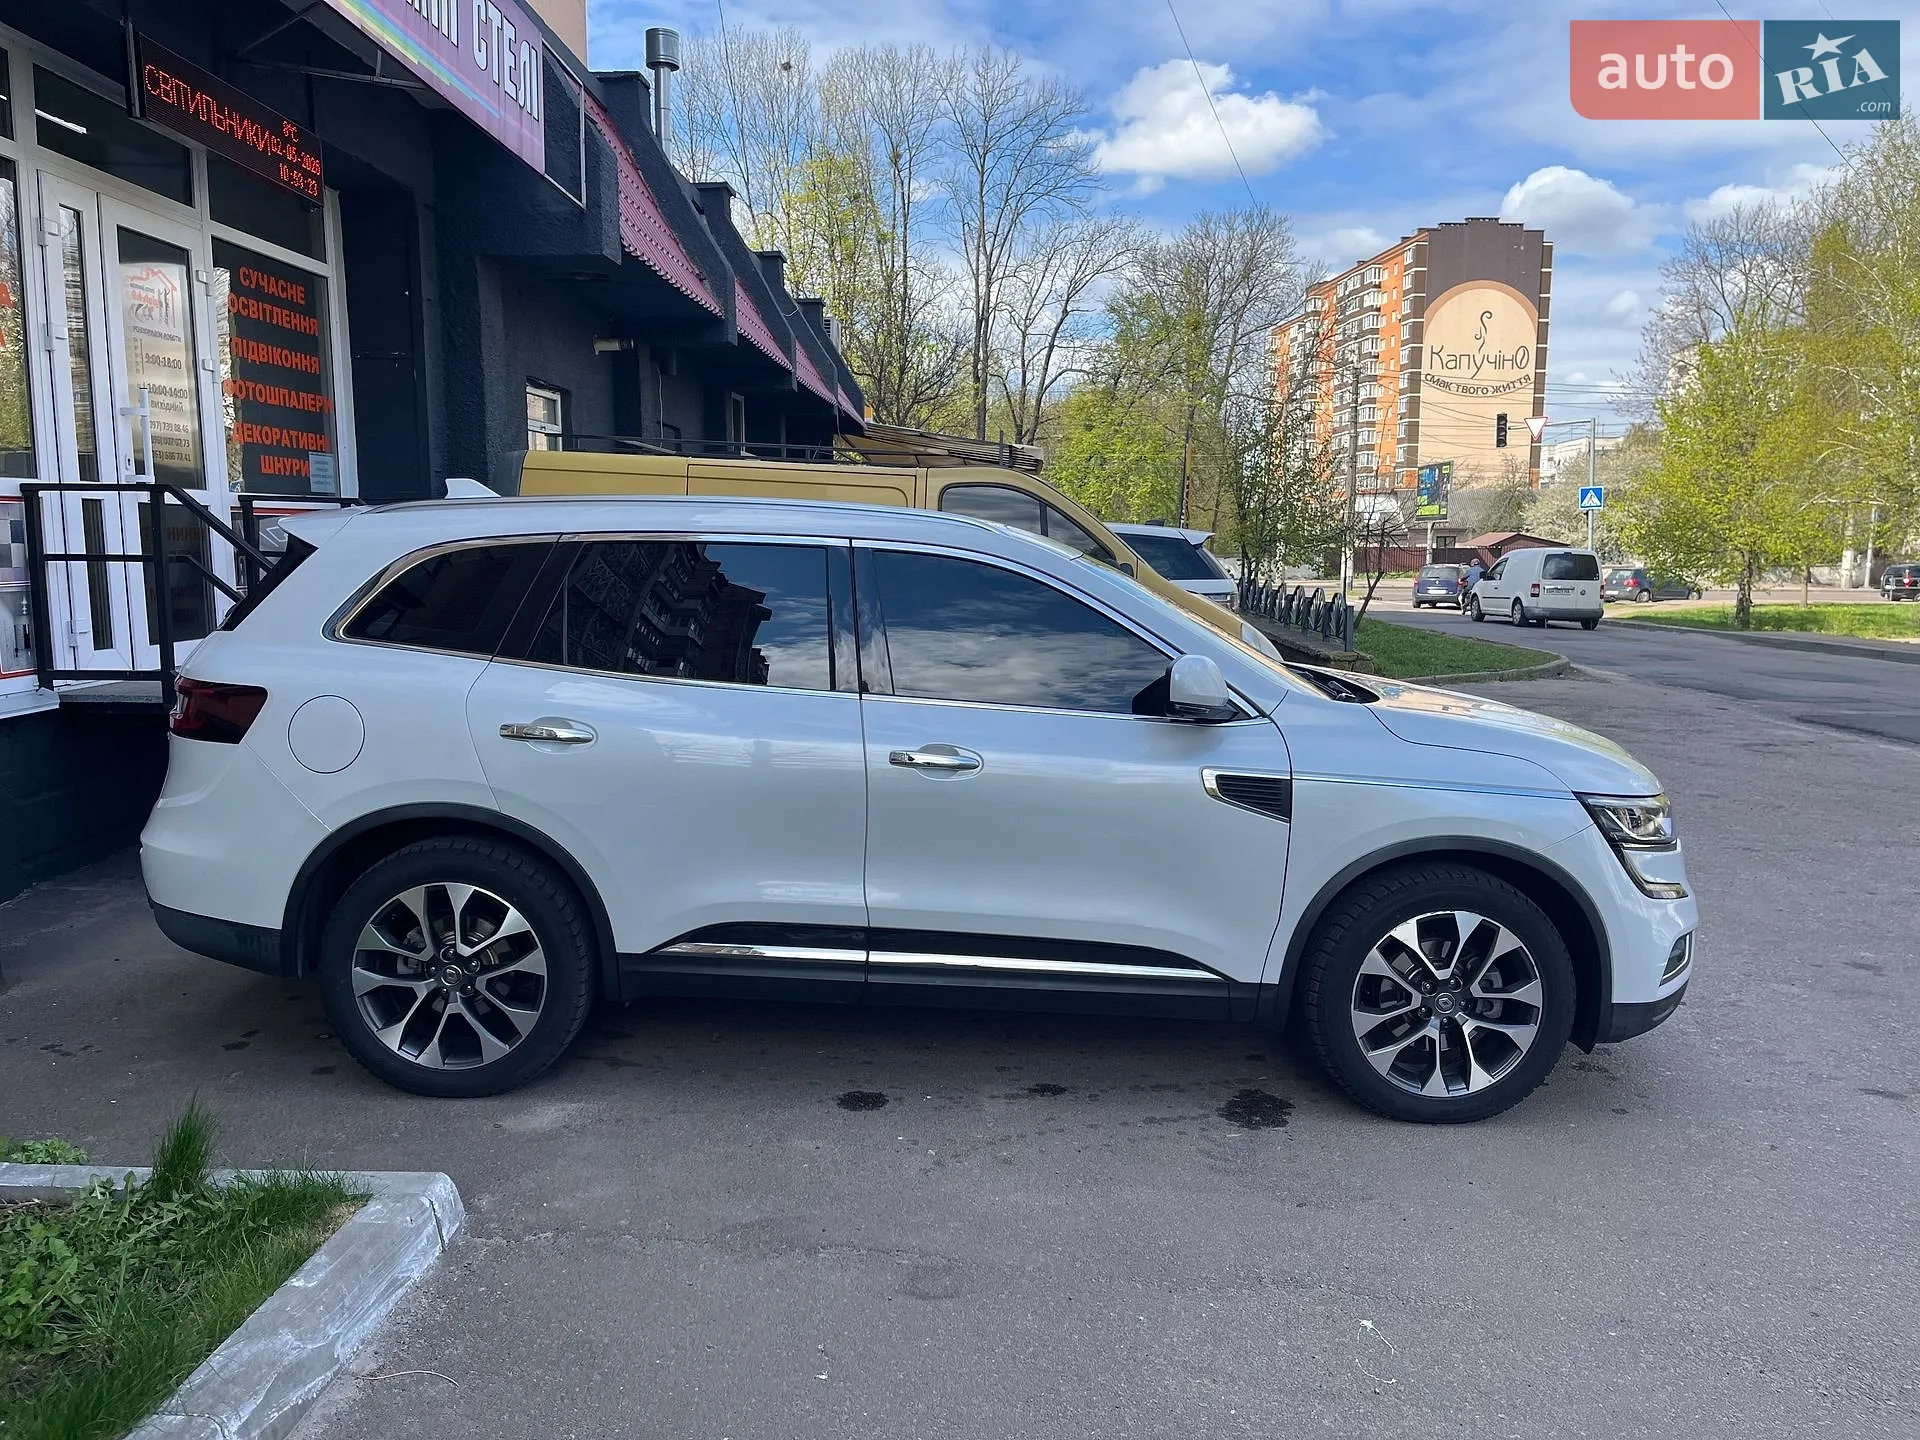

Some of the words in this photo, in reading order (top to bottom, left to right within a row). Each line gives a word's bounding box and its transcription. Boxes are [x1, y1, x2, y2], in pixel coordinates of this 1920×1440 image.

[472, 0, 540, 122] СТЕЛІ
[145, 64, 271, 156] СВІТИЛЬНИКИ
[239, 266, 305, 305] СУЧАСНЕ
[228, 292, 319, 336] ОСВІТЛЕННЯ
[231, 337, 320, 374] ПІДВІКОННЯ
[222, 378, 333, 415] ФОТОШПАЛЕРИ
[1424, 373, 1453, 391] смак
[1455, 382, 1489, 395] твого
[1491, 374, 1531, 394] життя
[232, 421, 331, 452] ДЕКОРАТИВНІ
[260, 455, 309, 478] ШНУРИ
